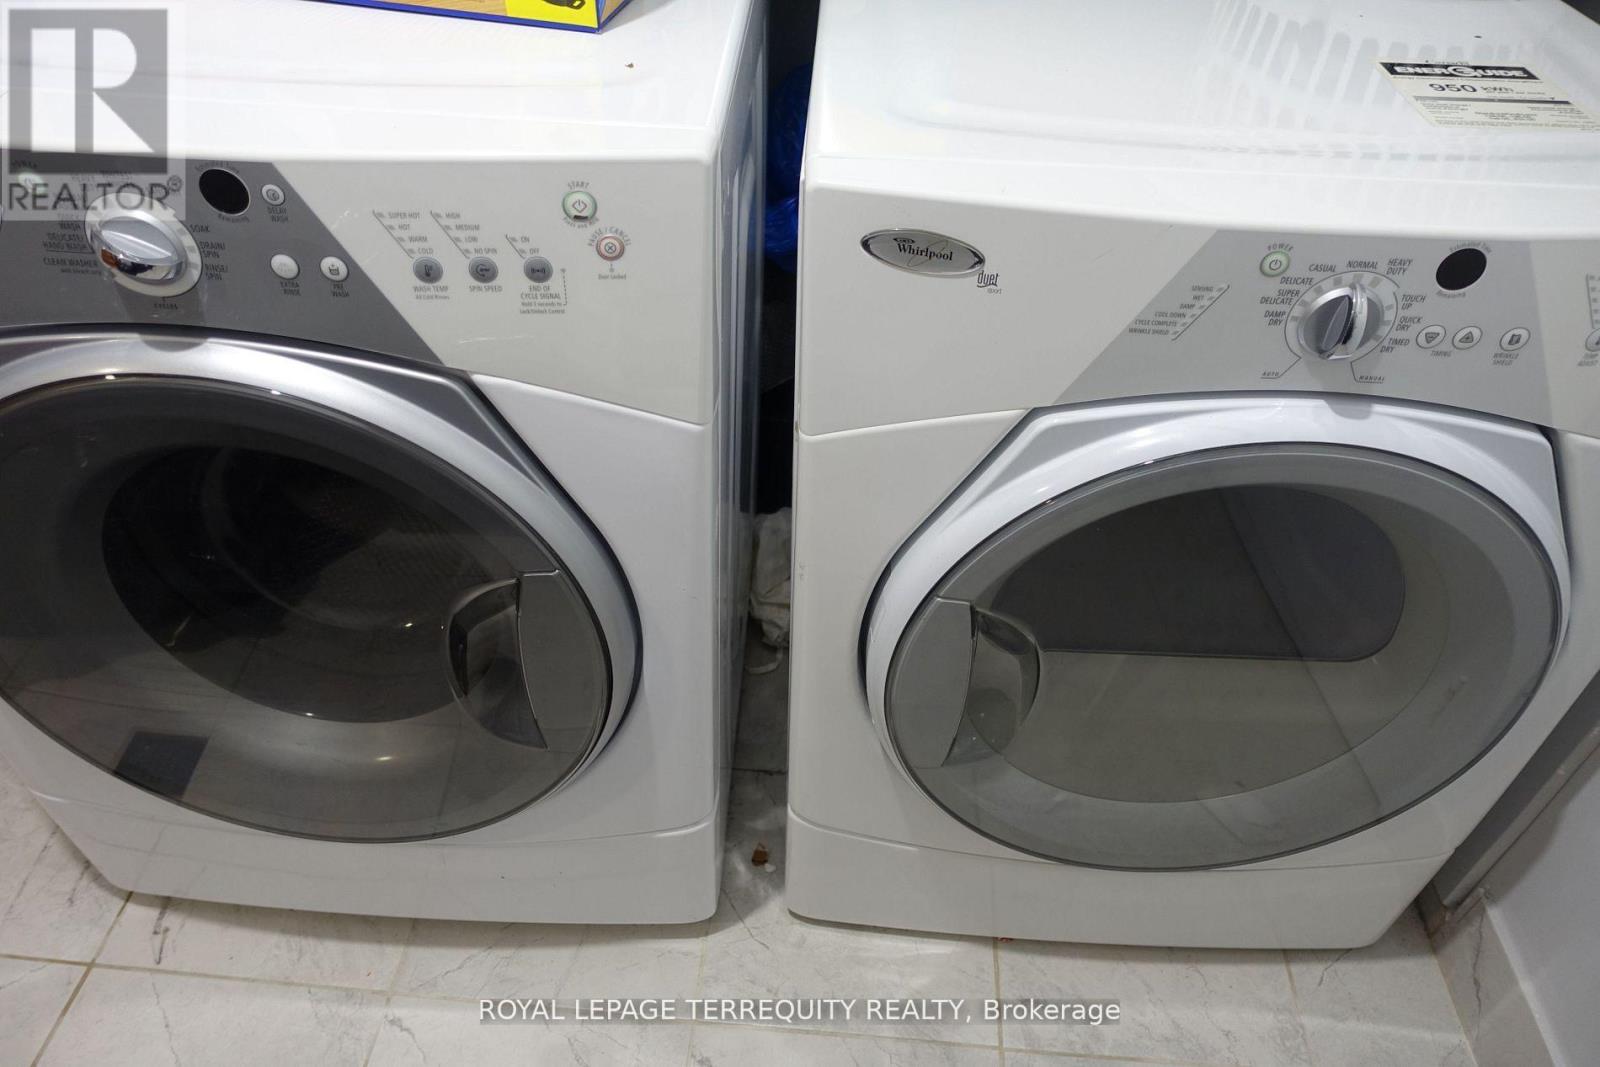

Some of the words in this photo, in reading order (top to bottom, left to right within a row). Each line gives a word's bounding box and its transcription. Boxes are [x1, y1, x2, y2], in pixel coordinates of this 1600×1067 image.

[1429, 83, 1478, 93] 950
[567, 181, 590, 190] START
[190, 225, 210, 233] SOAK
[897, 242, 953, 261] Whirlpool
[1267, 243, 1294, 252] POWER
[202, 250, 220, 259] SPIN
[1346, 260, 1378, 270] NORMAL
[1387, 258, 1413, 266] HEAVY
[1308, 264, 1337, 272] CASUAL
[1386, 267, 1407, 275] DUTY
[206, 272, 223, 281] SPIN
[977, 269, 999, 288] duet
[1280, 277, 1314, 286] DELICATE
[1277, 289, 1300, 297] SUPER
[1260, 296, 1294, 305] DELICATE
[1401, 294, 1426, 303] TOUCH
[1401, 302, 1413, 310] UP
[1264, 310, 1287, 318] DAMP
[1267, 318, 1283, 326] DRY
[1399, 316, 1423, 325] QUICK
[1128, 327, 1151, 335] WRINKLE
[1395, 324, 1411, 332] DRY
[1388, 338, 1410, 346] TIMED
[1380, 345, 1395, 353] DRY
[1492, 352, 1519, 360] WRINKLE
